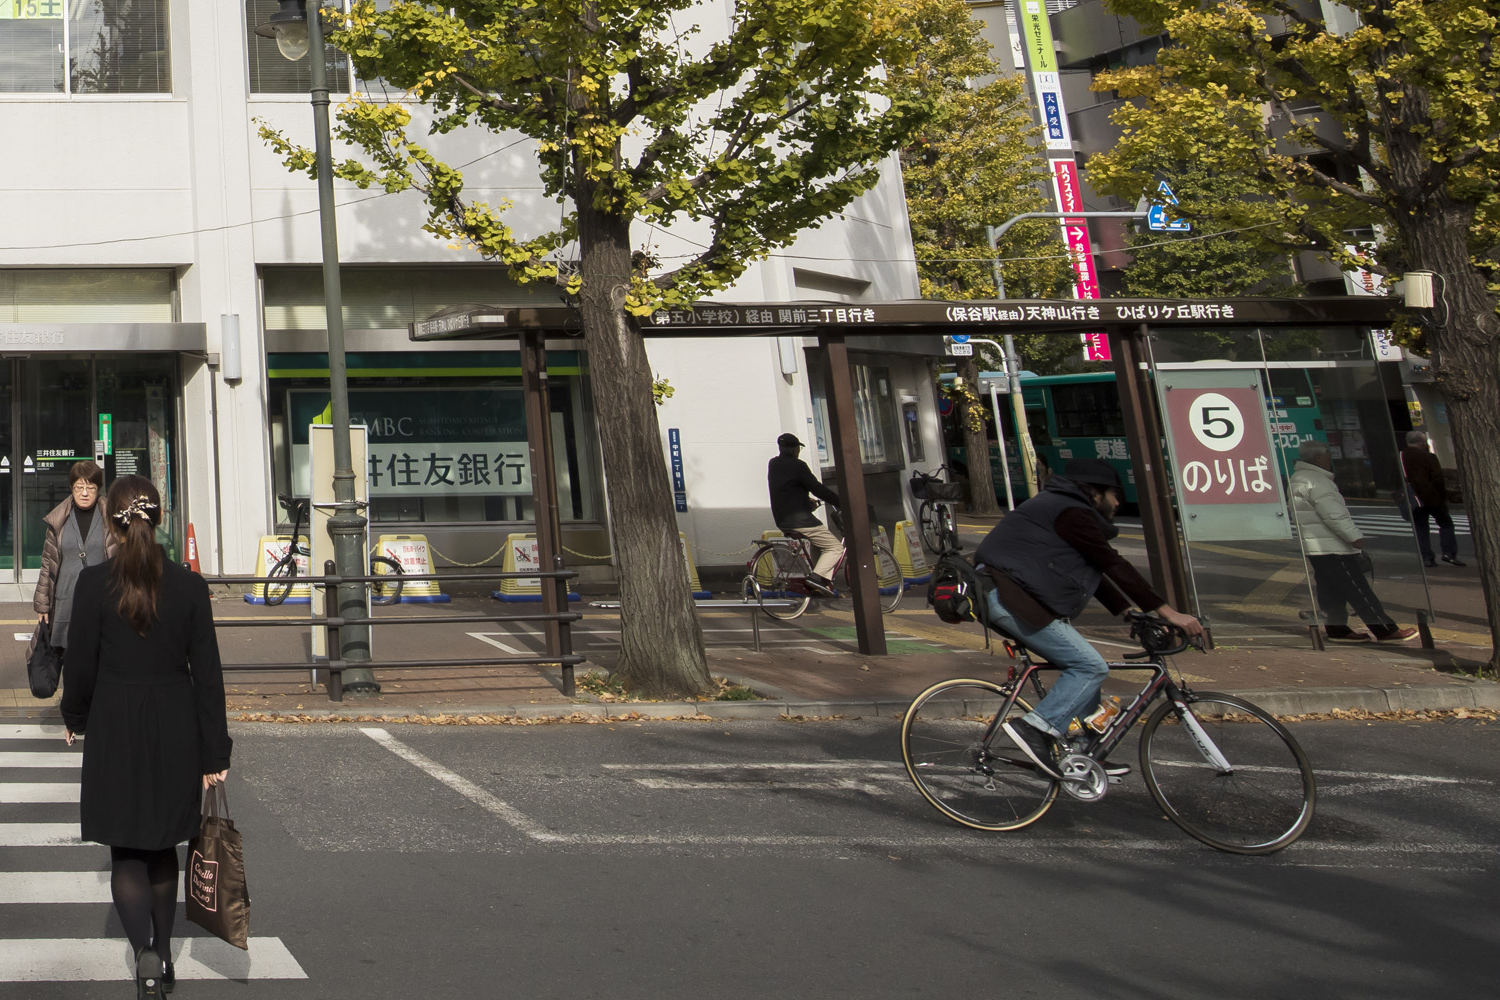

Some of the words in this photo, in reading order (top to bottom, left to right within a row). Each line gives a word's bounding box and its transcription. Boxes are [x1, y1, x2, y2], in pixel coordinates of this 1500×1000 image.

[1031, 14, 1048, 68] 栄光ゼミナール
[1045, 94, 1062, 138] 大学受験
[1060, 164, 1076, 212] ハウスメイ
[779, 308, 875, 323] 関前三丁目行き
[1202, 406, 1235, 439] 5
[368, 452, 525, 487] 井住友銀行
[672, 444, 681, 478] 中町一丁目
[1182, 454, 1272, 496] のりば
[1184, 720, 1210, 757] OCUS
